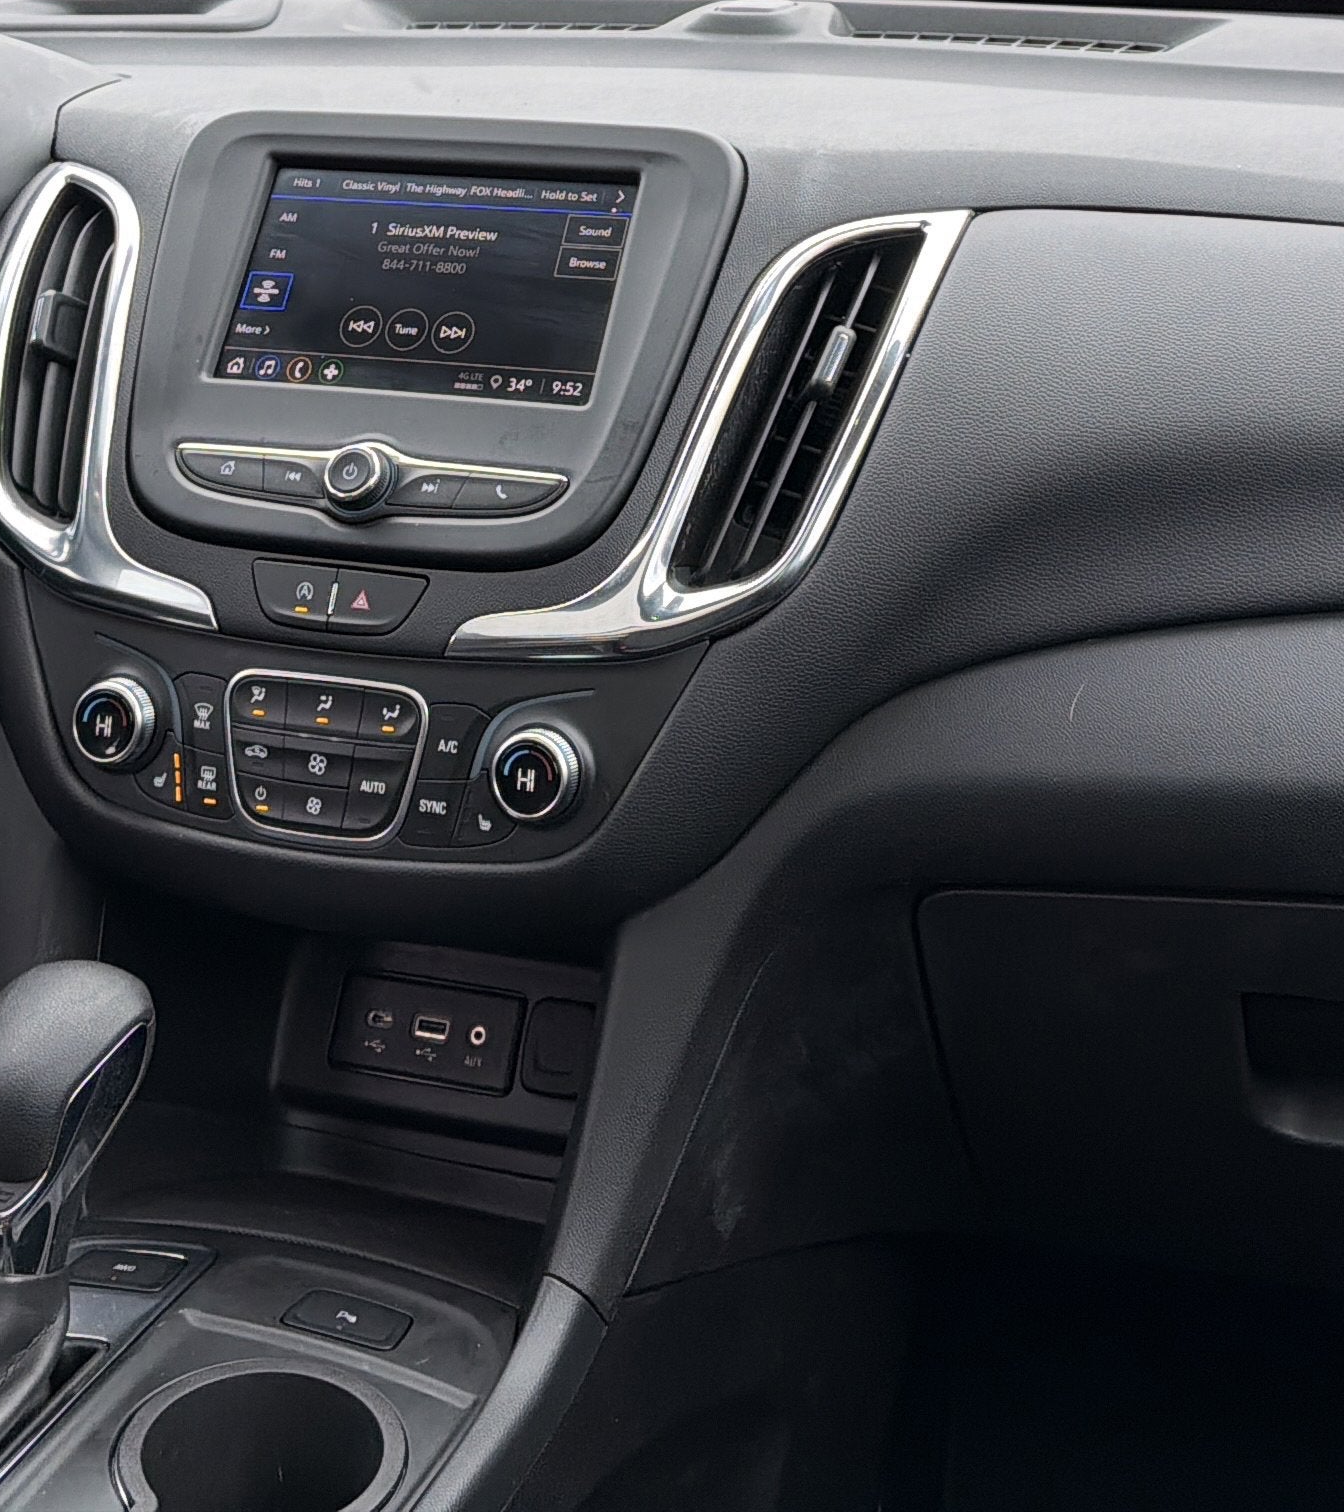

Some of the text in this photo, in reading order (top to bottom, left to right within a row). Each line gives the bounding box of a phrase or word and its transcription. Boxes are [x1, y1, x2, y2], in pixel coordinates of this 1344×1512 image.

[293, 178, 321, 188] Hits 1
[342, 179, 401, 194] Classic Vinyl
[406, 183, 467, 198] The Highway
[470, 186, 533, 199] FOX Headli...
[541, 190, 597, 202] Hold to Set
[279, 213, 297, 223] AM
[371, 222, 498, 241] 1 SiriusXM Preview
[579, 226, 612, 237] Sound
[269, 249, 286, 259] FM
[378, 241, 480, 258] Great Offer Now!
[382, 259, 466, 274] 844-711-8800
[569, 257, 607, 269] Browse
[235, 323, 261, 335] More
[395, 324, 418, 336] Tune
[458, 372, 484, 381] 4G LTE
[507, 377, 532, 392] 34°
[552, 381, 583, 397] 9:52
[95, 714, 113, 738] HI
[193, 720, 210, 731] MAX
[437, 739, 458, 754] A/C
[197, 779, 217, 791] REAR
[516, 768, 535, 792] HI
[360, 780, 386, 795] AUTO
[419, 799, 447, 816] SYNC
[464, 1055, 482, 1067] AUX
[112, 1263, 137, 1272] AWD
